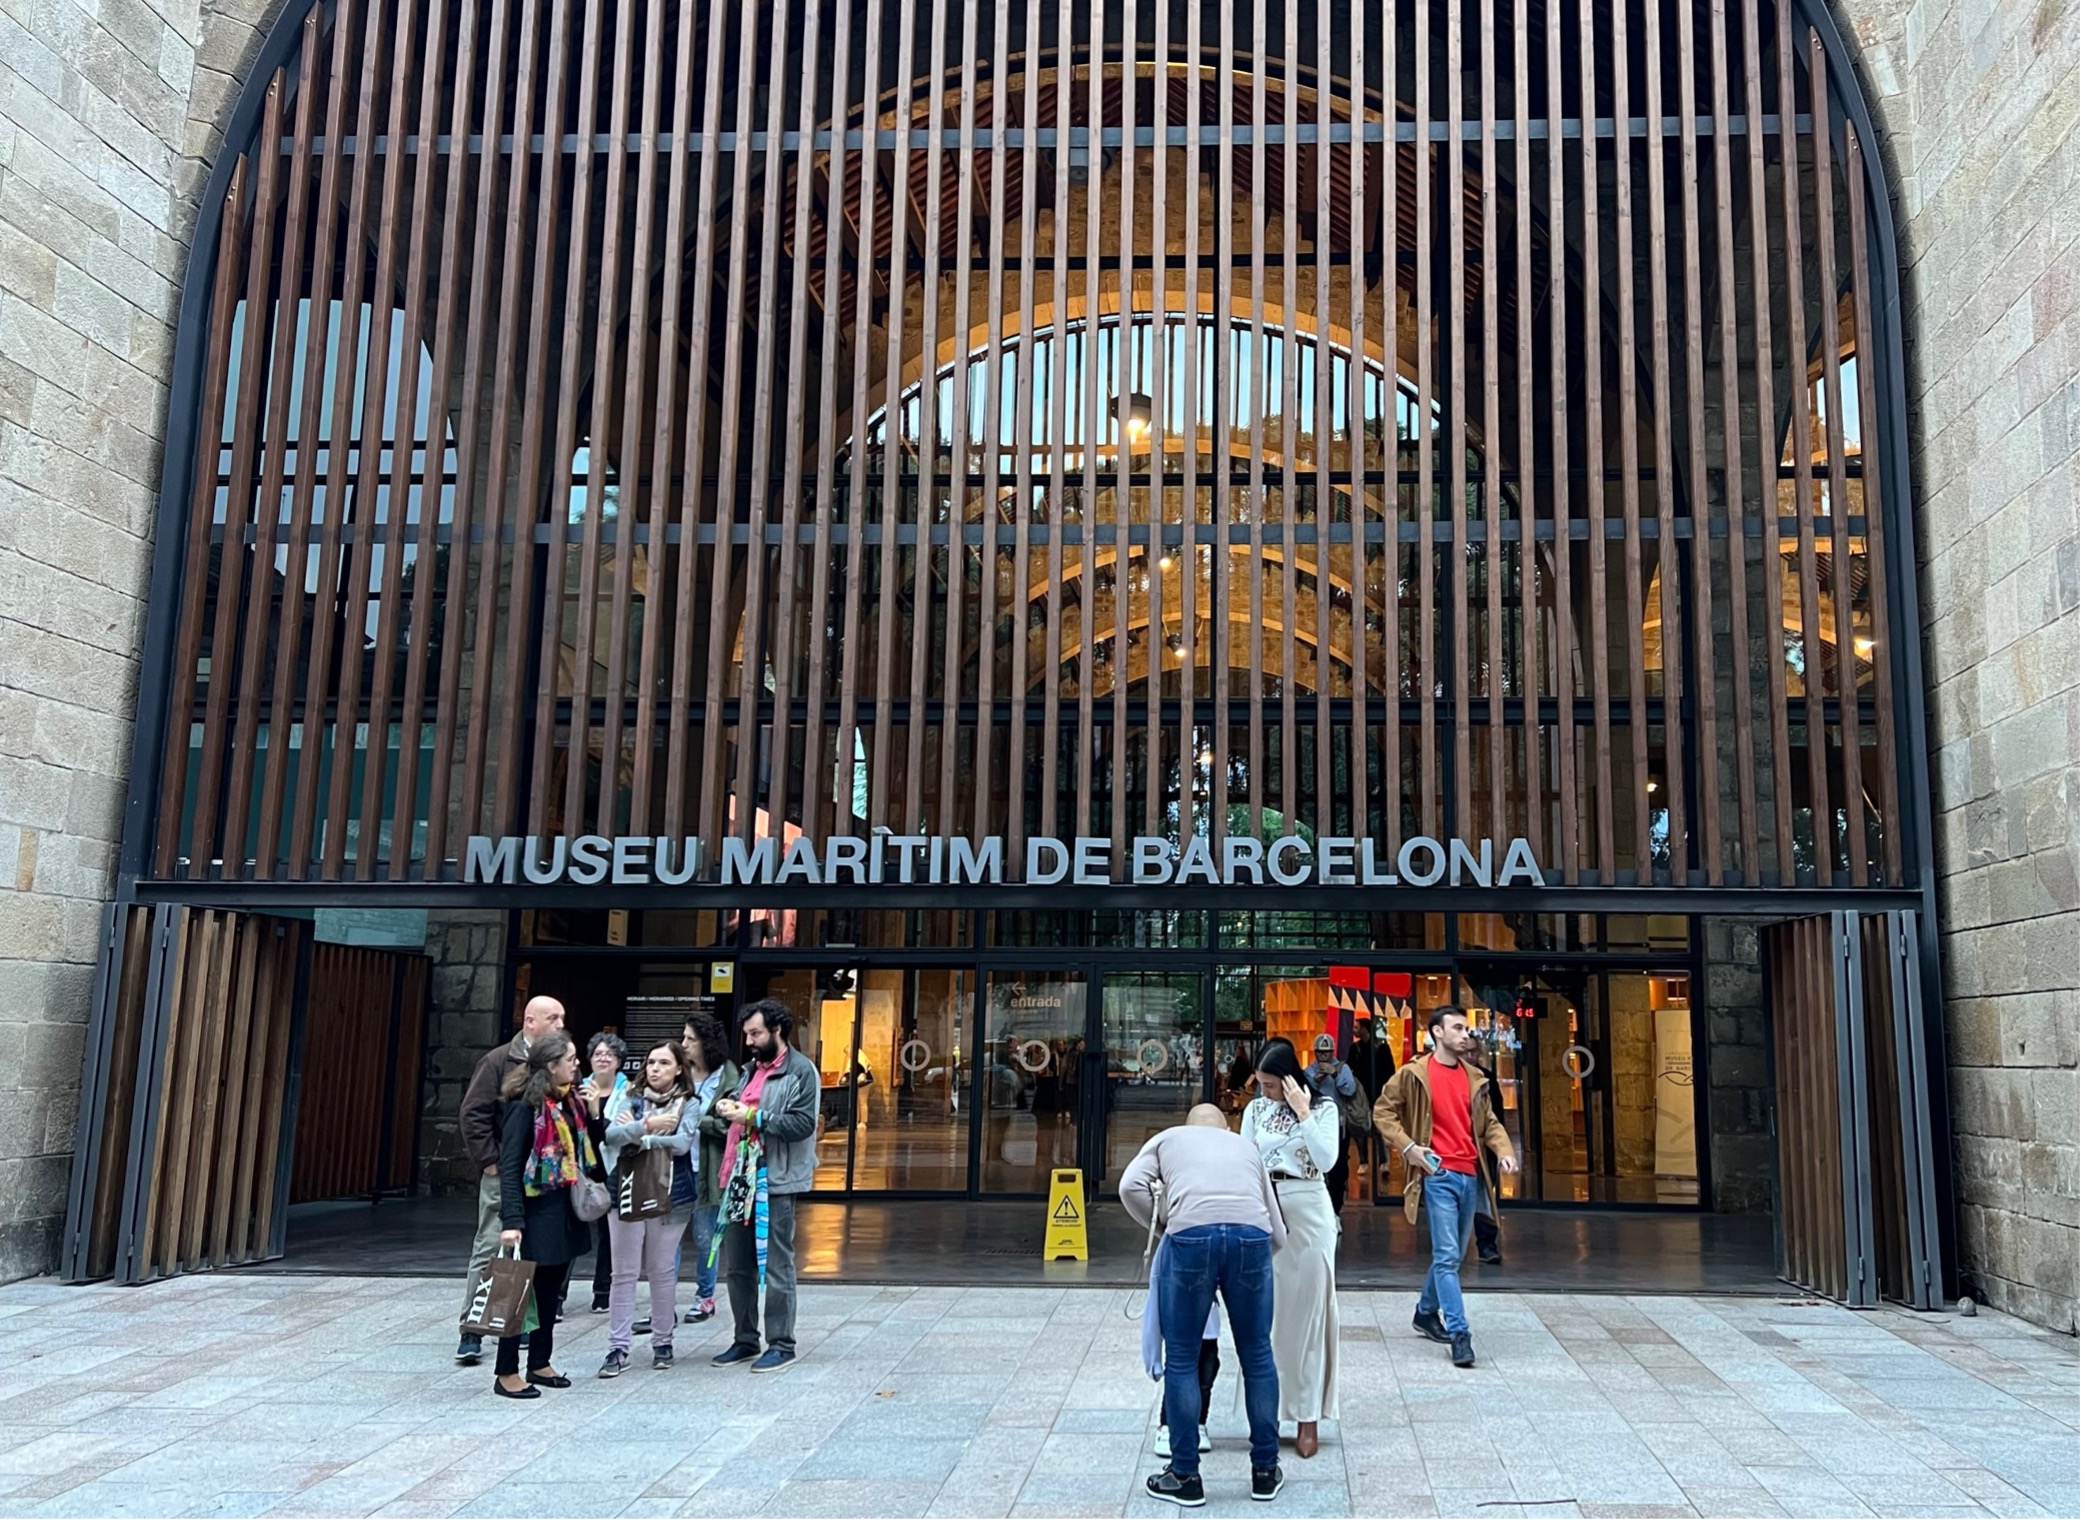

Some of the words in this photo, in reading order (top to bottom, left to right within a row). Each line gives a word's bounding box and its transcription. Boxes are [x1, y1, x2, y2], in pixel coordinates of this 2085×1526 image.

[464, 835, 703, 886] MUSEU
[720, 825, 1003, 886] MARÍTIM
[1026, 837, 1111, 885] DE
[1133, 836, 1546, 888] BARCELONA
[1010, 995, 1061, 1008] entrada
